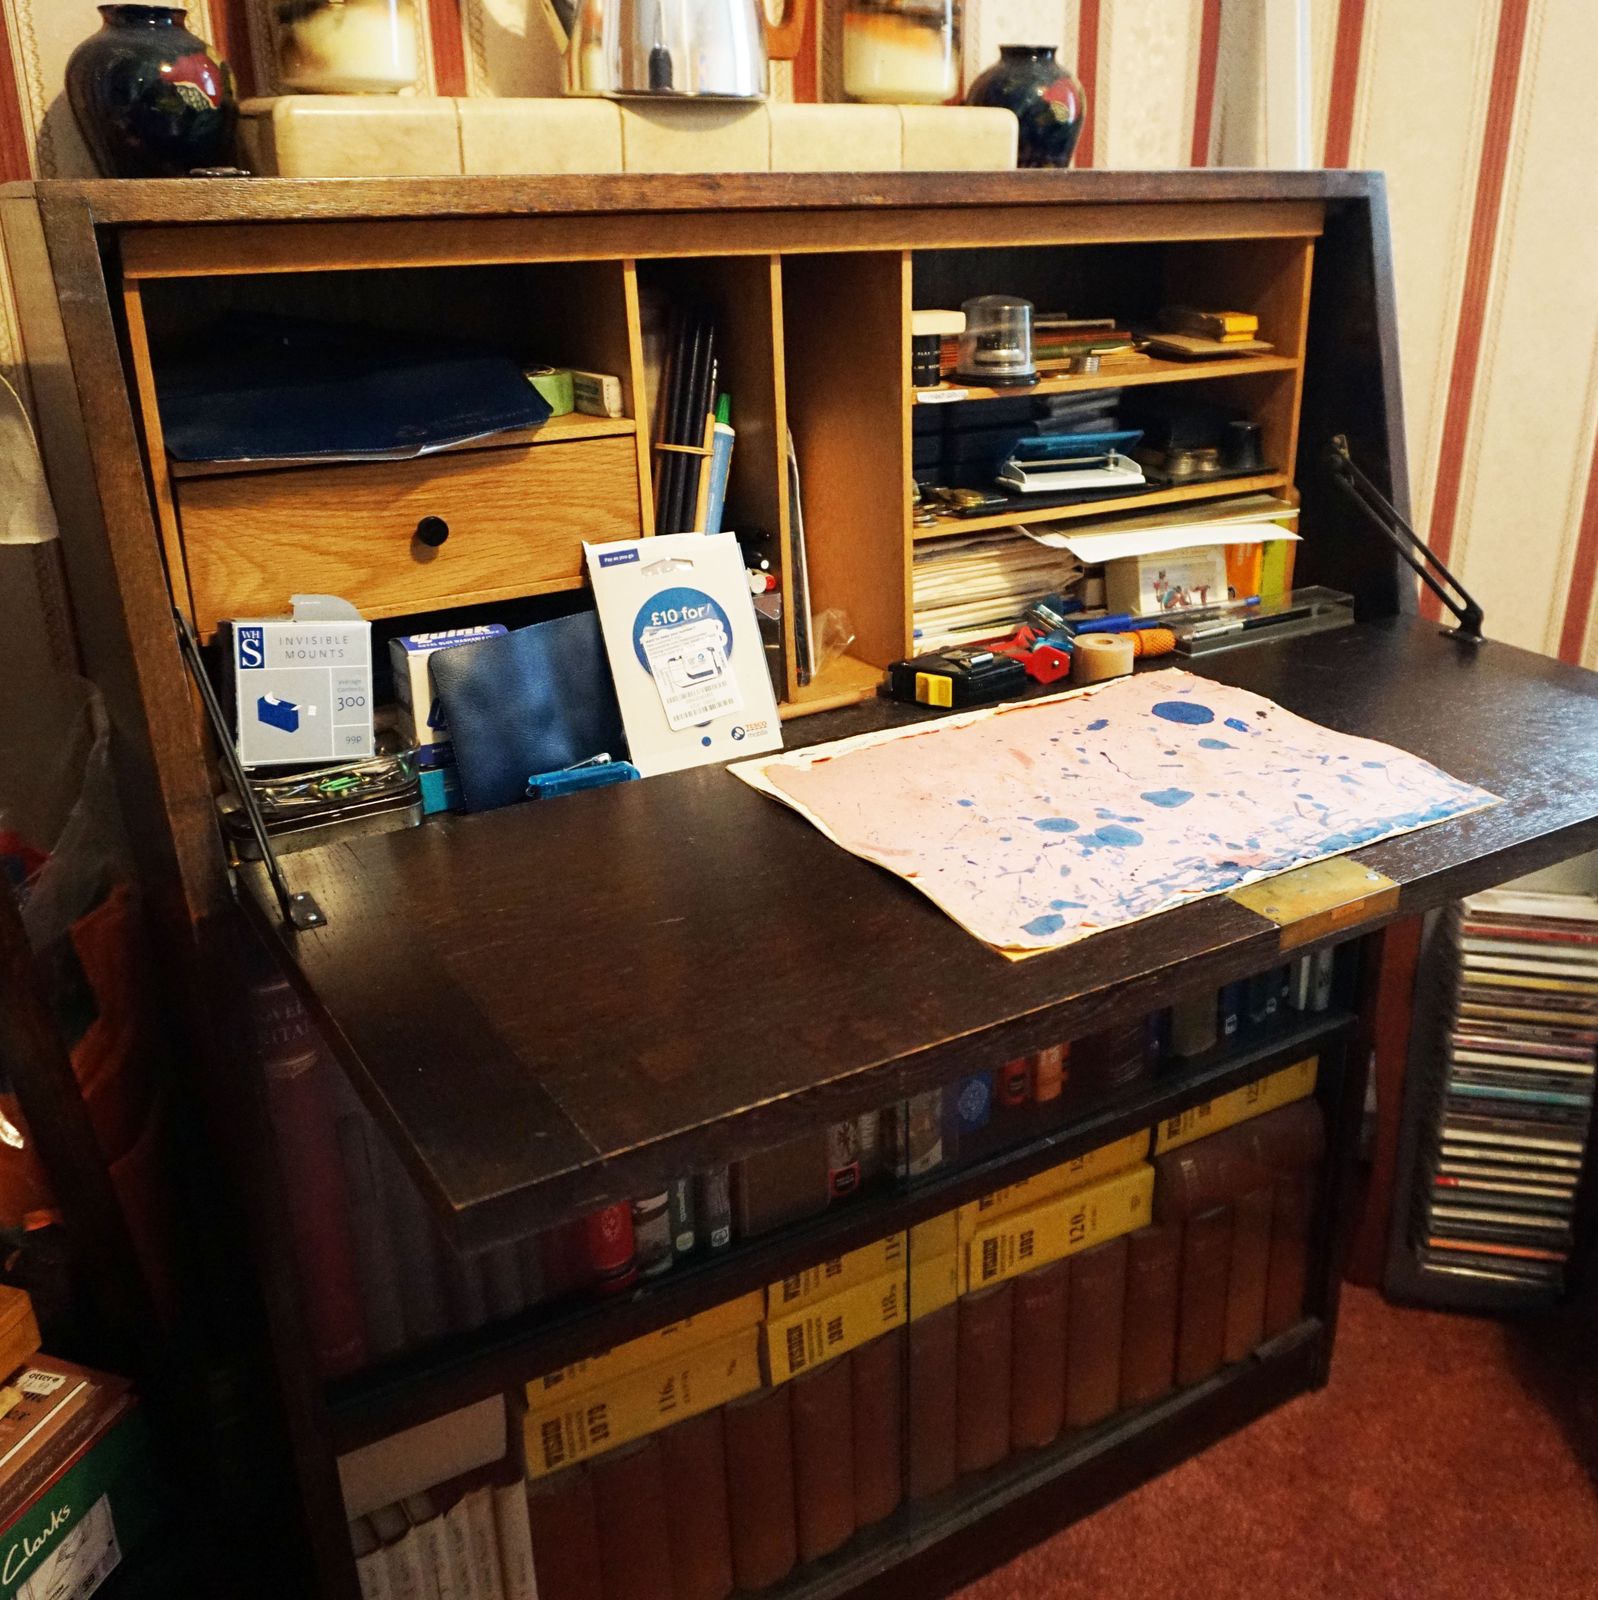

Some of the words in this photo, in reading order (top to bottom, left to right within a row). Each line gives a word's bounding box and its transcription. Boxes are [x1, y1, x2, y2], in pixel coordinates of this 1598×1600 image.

[651, 609, 679, 626] £10
[681, 606, 705, 620] for
[241, 630, 260, 639] WH
[279, 635, 350, 646] INVISIBLE
[285, 648, 345, 659] MOUNTS
[337, 696, 365, 712] 300
[745, 720, 768, 729] TESCO
[982, 1236, 998, 1281] WISDEN
[786, 1324, 805, 1373] WISDEN
[541, 1417, 564, 1468] WISDEN
[2, 1504, 71, 1585] Clarks
